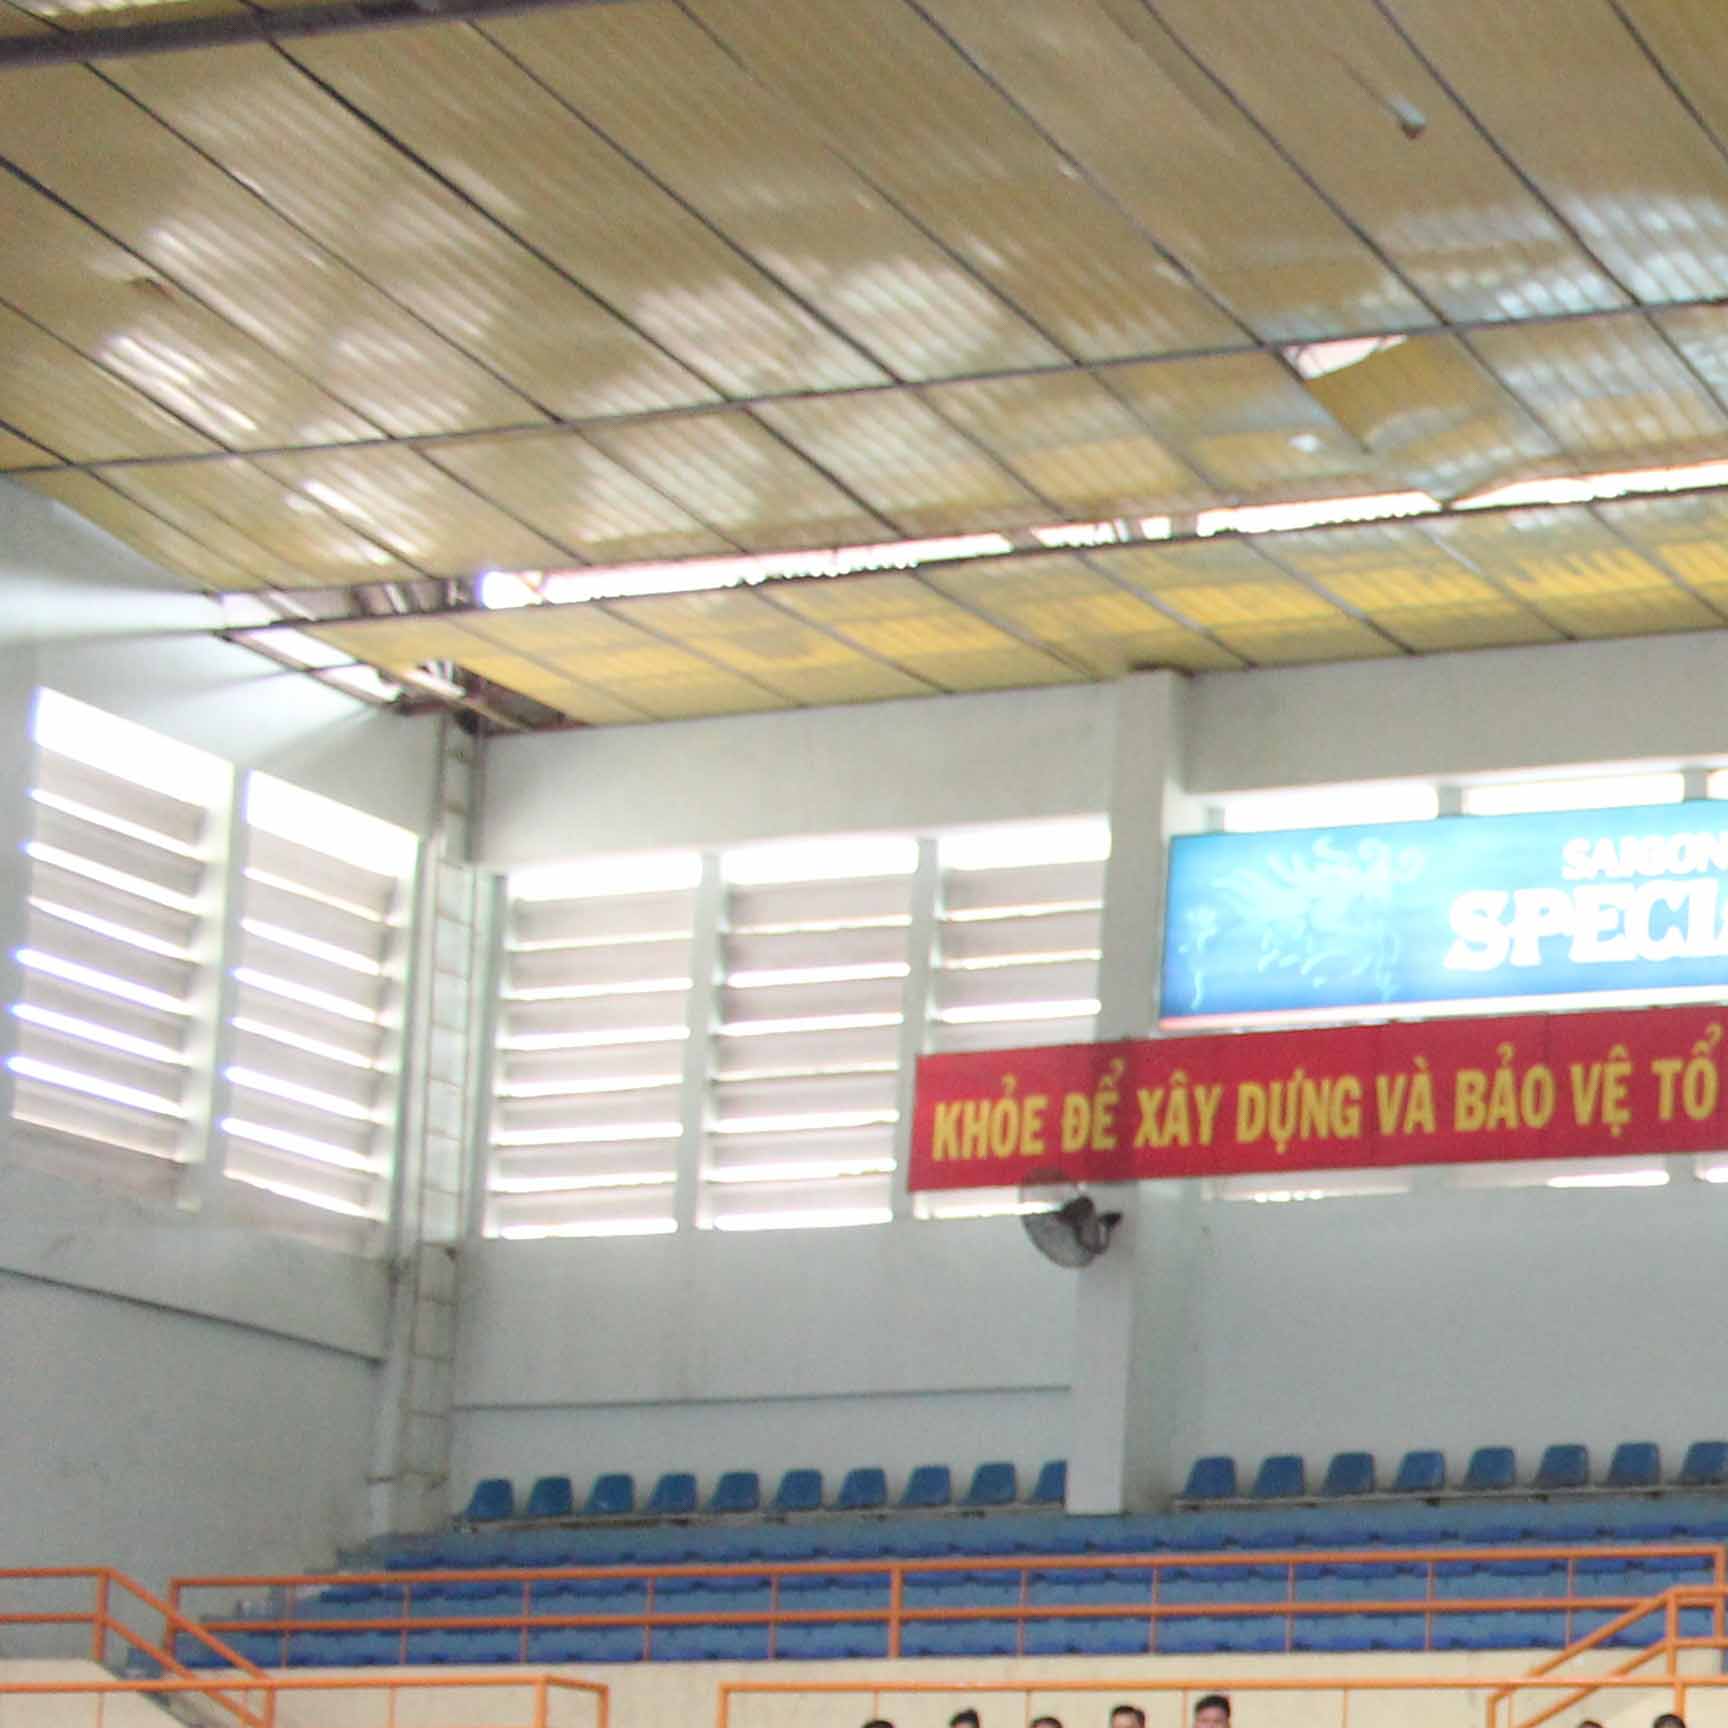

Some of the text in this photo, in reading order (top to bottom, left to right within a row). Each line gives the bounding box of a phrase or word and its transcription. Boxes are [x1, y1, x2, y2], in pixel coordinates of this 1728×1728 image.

[932, 1076, 1047, 1160] KHỎE
[1060, 1061, 1126, 1153] ĐỂ
[1135, 1071, 1221, 1147] XÂY
[1235, 1082, 1364, 1156] DỰNG
[1375, 1057, 1438, 1136] VÀ
[1453, 1046, 1555, 1132] BẢO
[1569, 1047, 1634, 1138] VỆ
[1656, 1025, 1722, 1123] TỔ
